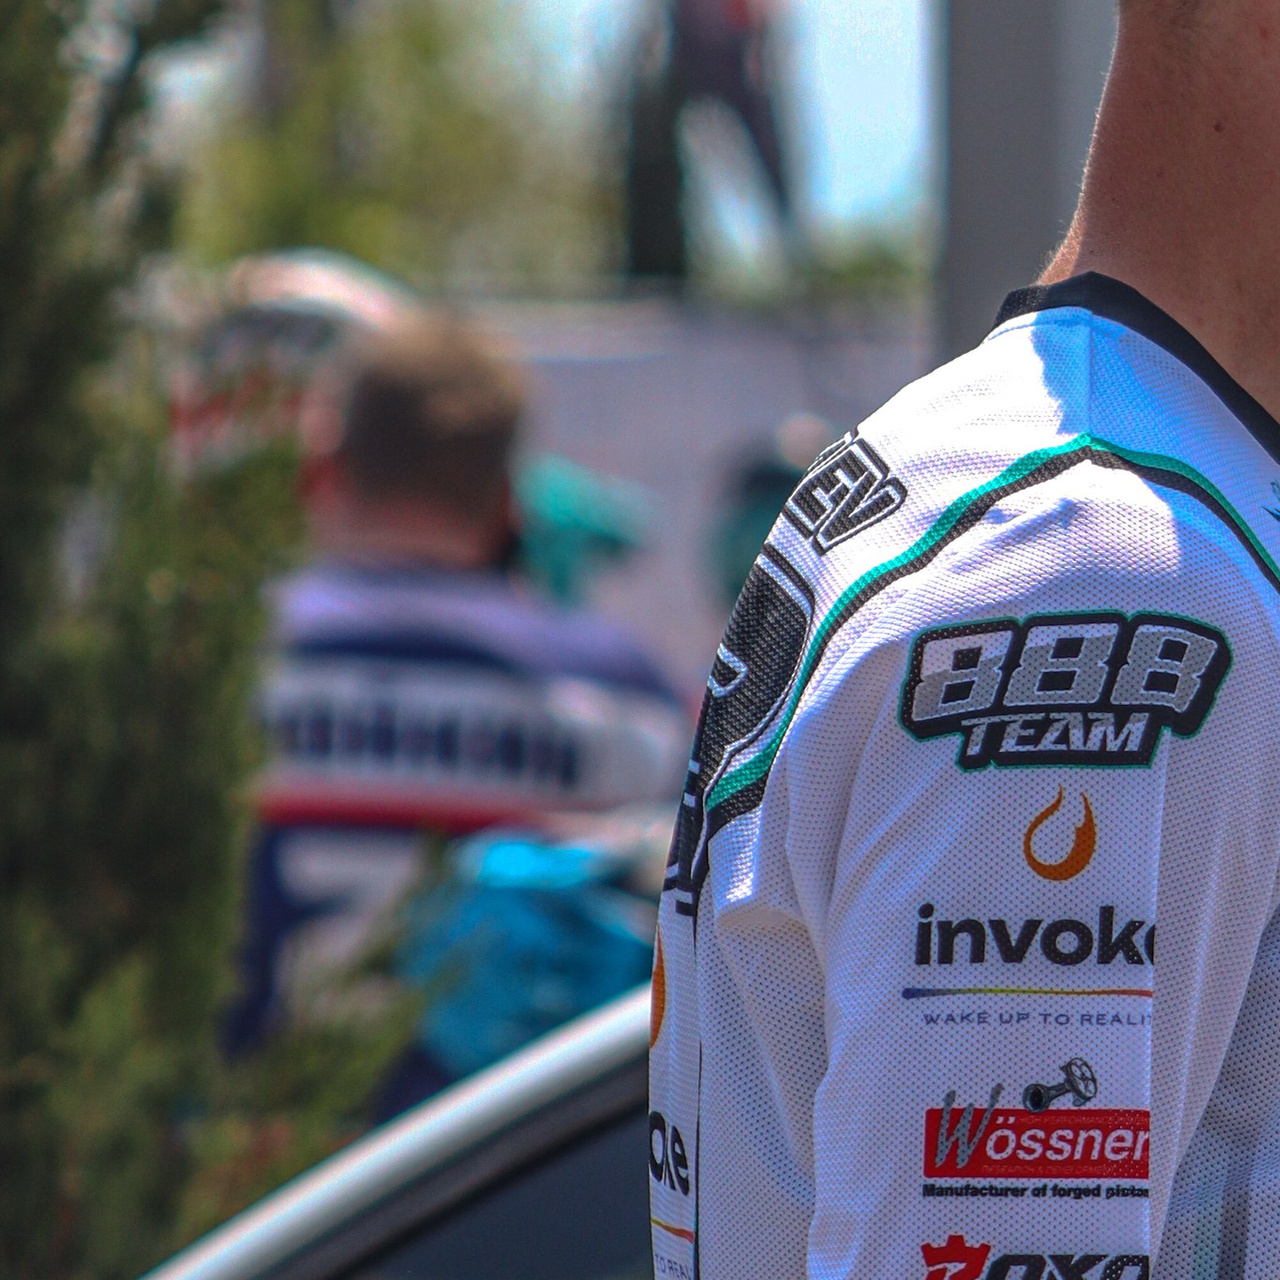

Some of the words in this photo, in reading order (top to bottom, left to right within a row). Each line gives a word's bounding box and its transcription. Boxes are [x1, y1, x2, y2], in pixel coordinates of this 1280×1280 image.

[911, 622, 1218, 721] 888
[961, 712, 1149, 756] TEAM
[923, 1012, 988, 1026] WAKE
[999, 1012, 1030, 1025] UP
[1039, 1012, 1070, 1026] TO
[1080, 1013, 1153, 1026] REALI
[934, 1083, 1150, 1168] Wössner
[922, 1184, 1028, 1197] Manufacturer
[1031, 1184, 1047, 1197] of
[1050, 1184, 1101, 1199] forged
